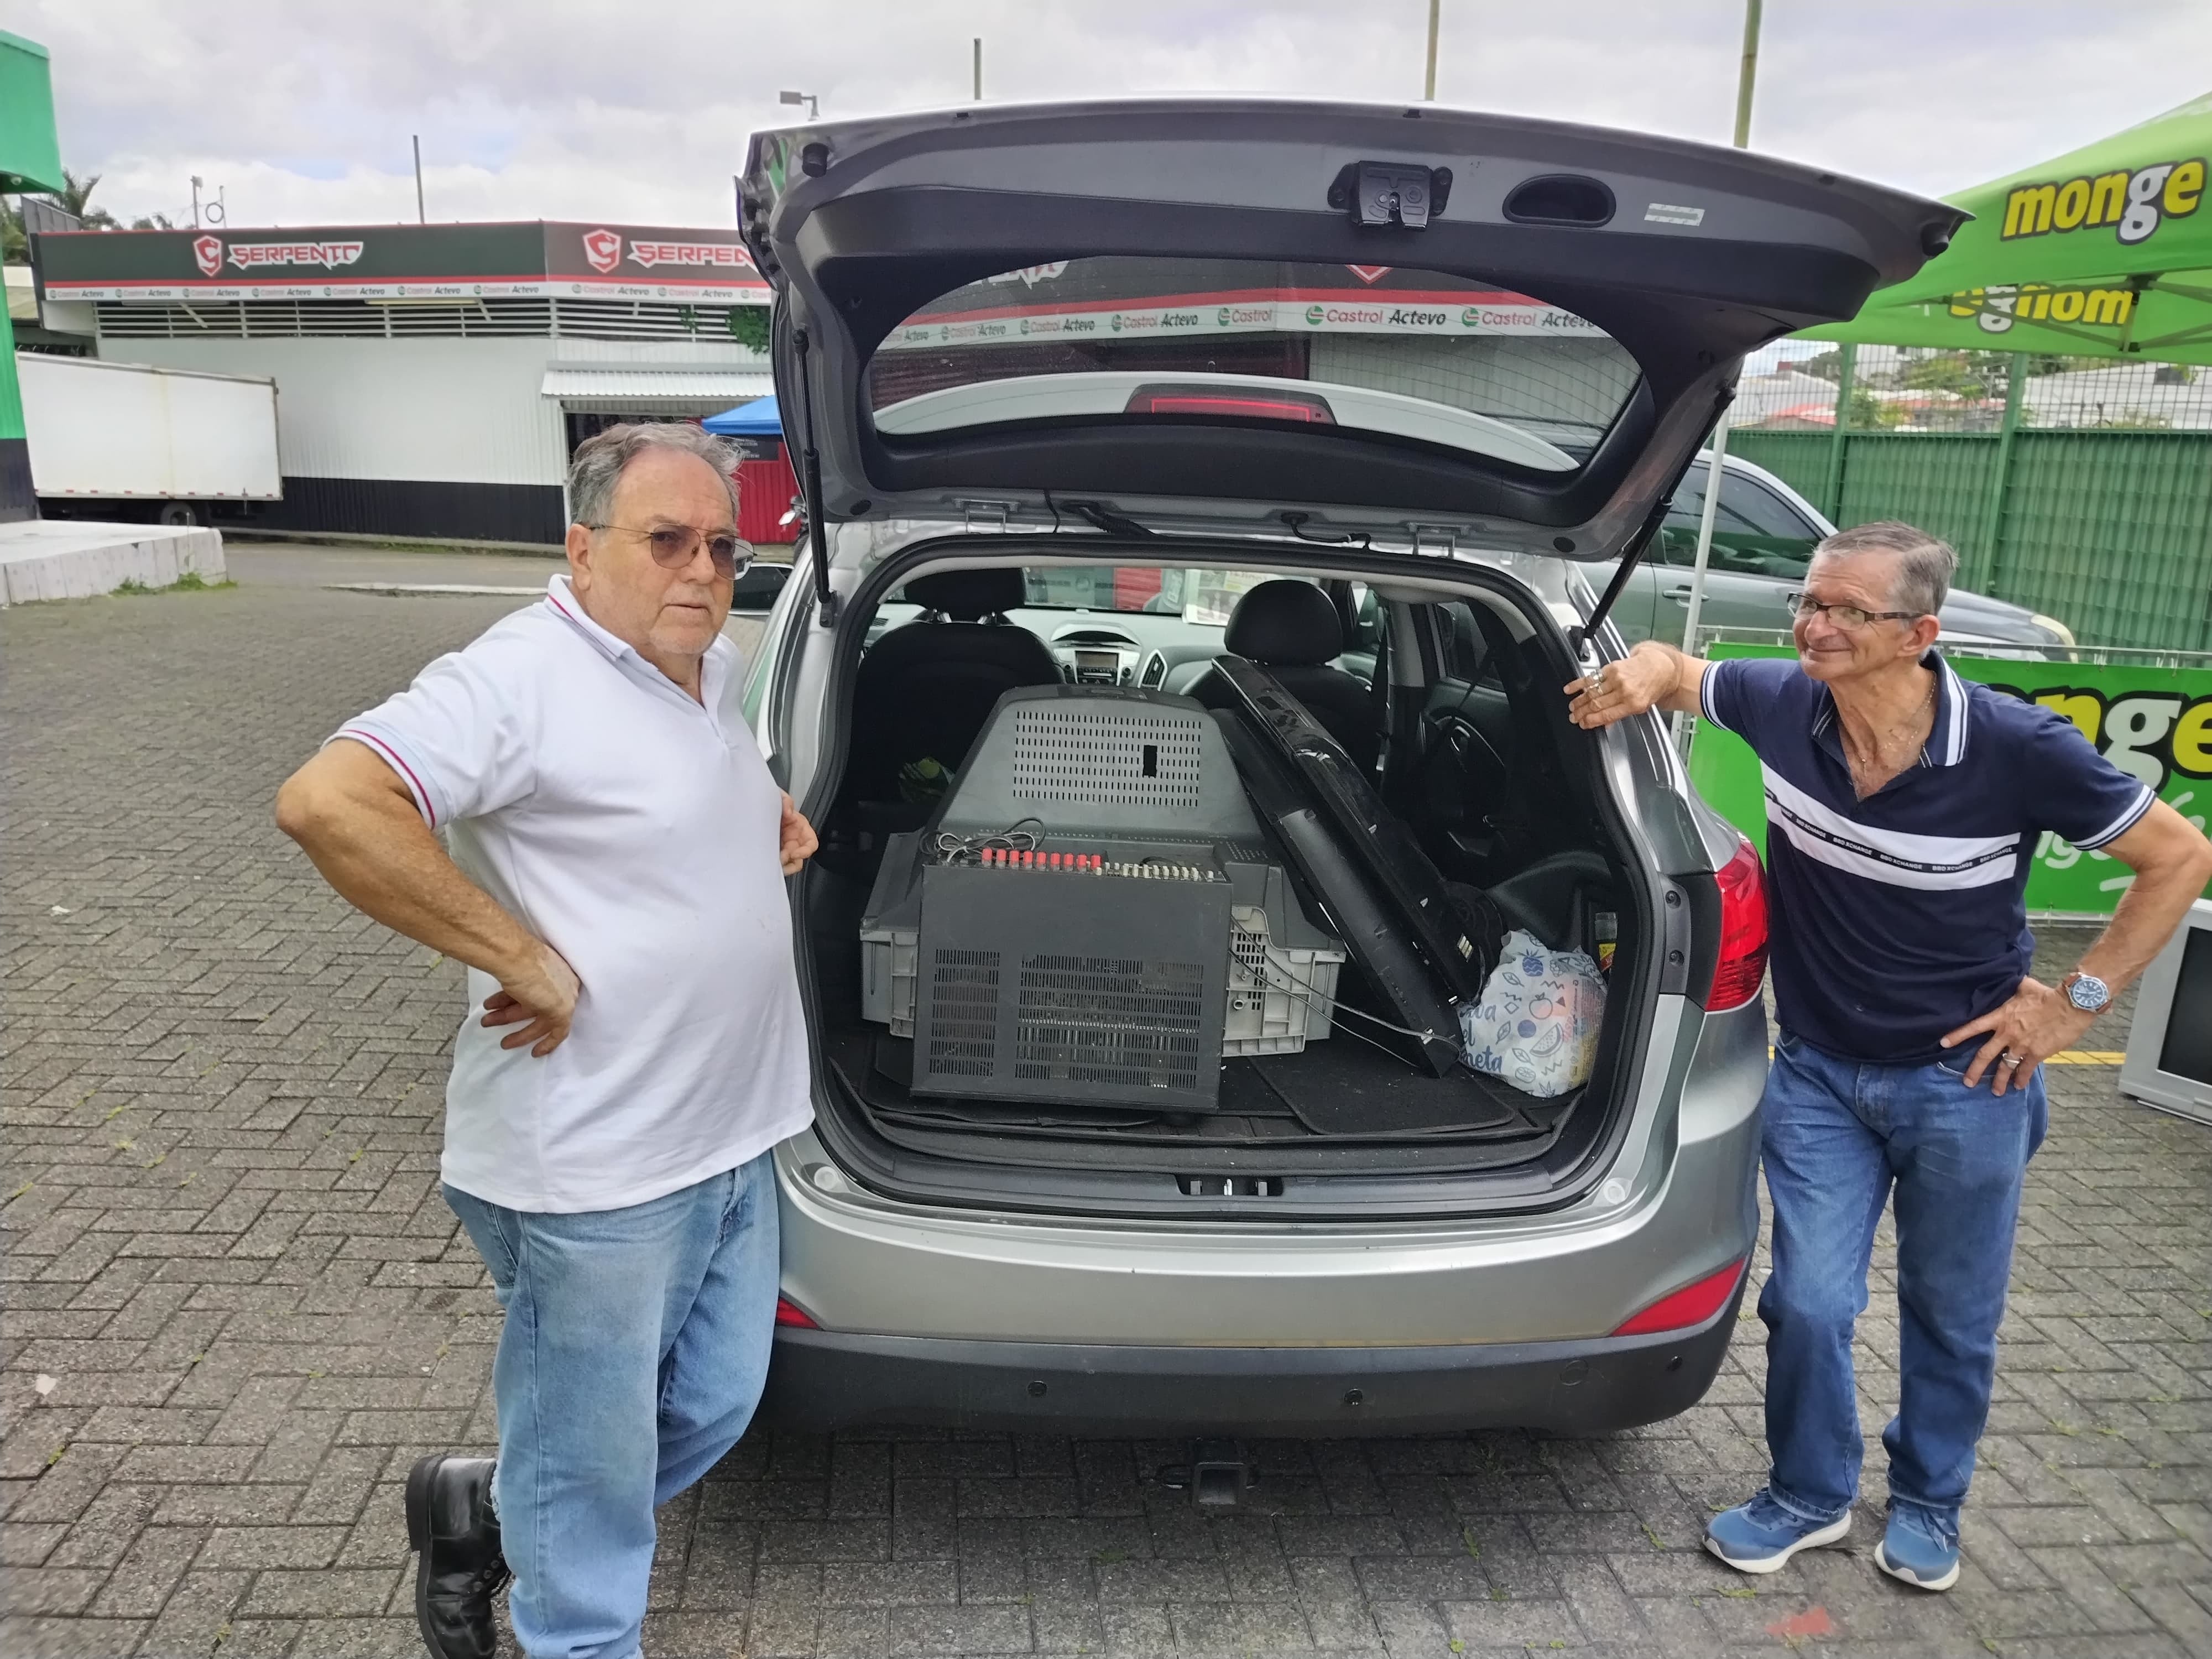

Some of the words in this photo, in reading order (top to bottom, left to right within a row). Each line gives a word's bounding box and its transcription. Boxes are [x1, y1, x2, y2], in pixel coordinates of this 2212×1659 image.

[2000, 158, 2206, 244] monge
[630, 242, 757, 268] SERPEN
[618, 286, 649, 295] Actevo
[702, 289, 733, 298] Actevo
[1124, 315, 1158, 329] Castrol
[1161, 313, 1198, 328] Actevo
[1232, 309, 1272, 324] Castrol
[1327, 309, 1383, 324] Castrol
[1389, 309, 1446, 326] Actevo
[1482, 311, 1537, 327] Castrol
[1063, 318, 1095, 332] Actevo
